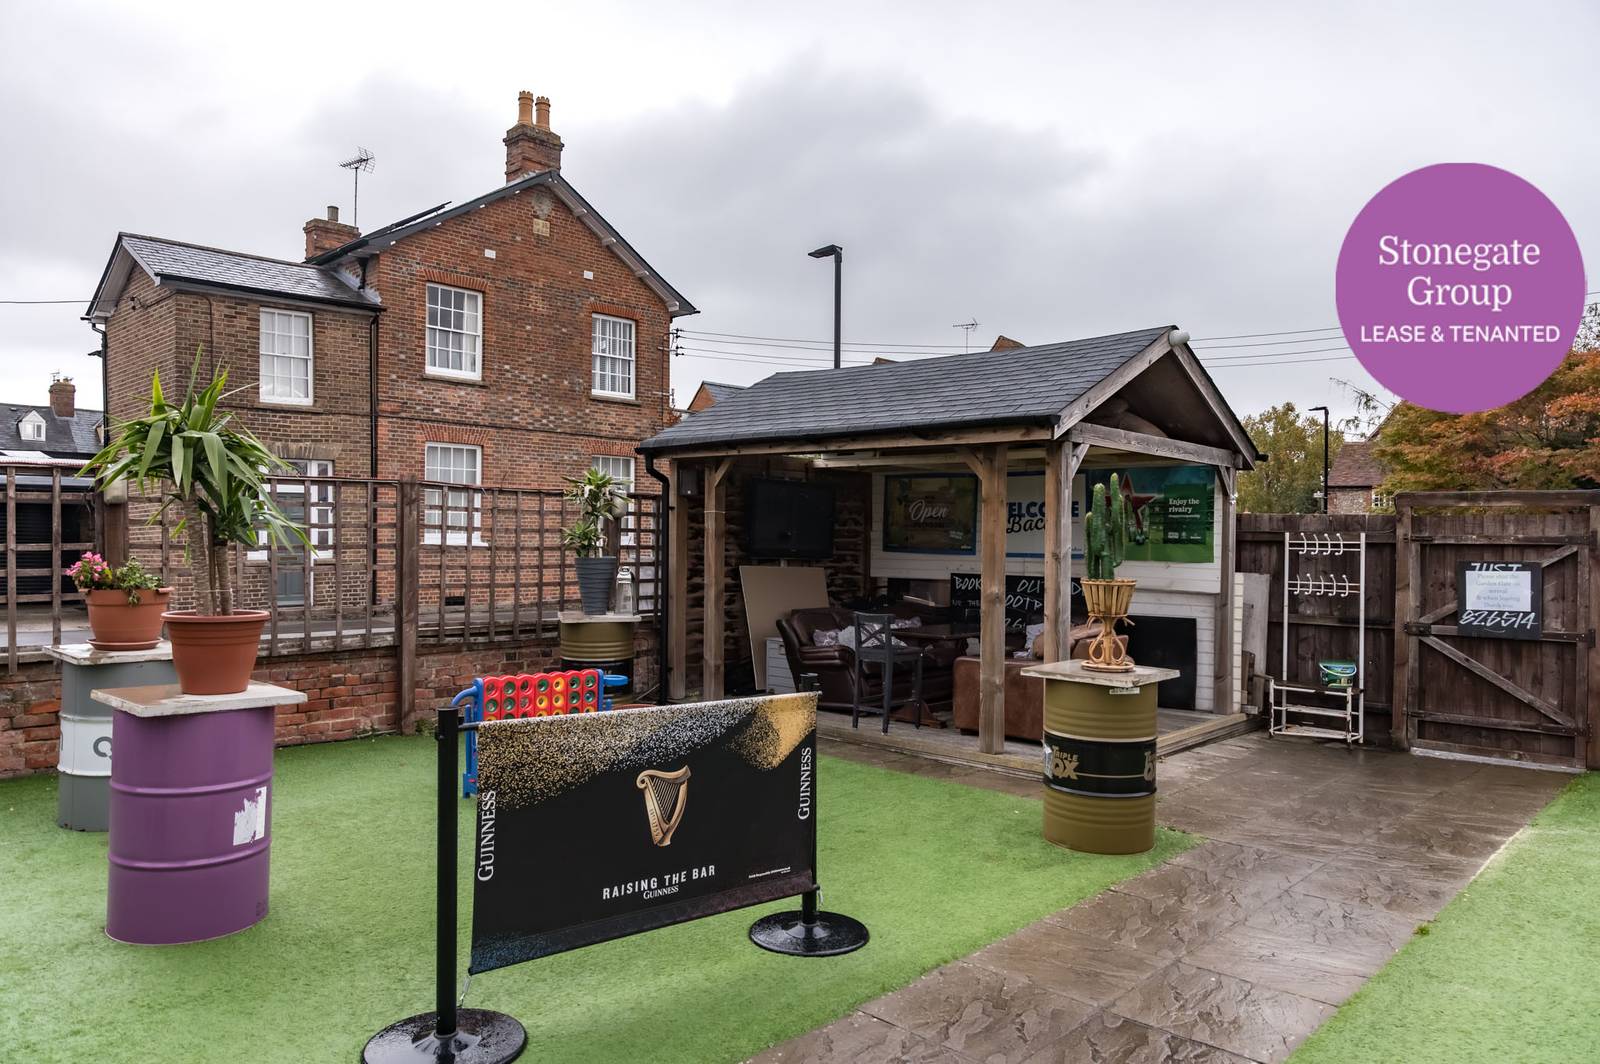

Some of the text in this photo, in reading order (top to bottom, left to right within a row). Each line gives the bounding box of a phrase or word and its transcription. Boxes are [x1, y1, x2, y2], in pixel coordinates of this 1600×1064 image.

[909, 499, 950, 523] Open
[1006, 501, 1080, 518] ELCE
[1168, 498, 1188, 506] Enjoy
[1168, 506, 1192, 514] rivalry
[1006, 514, 1046, 534] Bac
[1052, 745, 1079, 762] TRIPLE
[798, 747, 812, 820] GUINNESS
[477, 790, 496, 882] GUINNESS
[602, 865, 715, 900] RAISING THE BAR
[643, 885, 679, 900] GUINNESS
